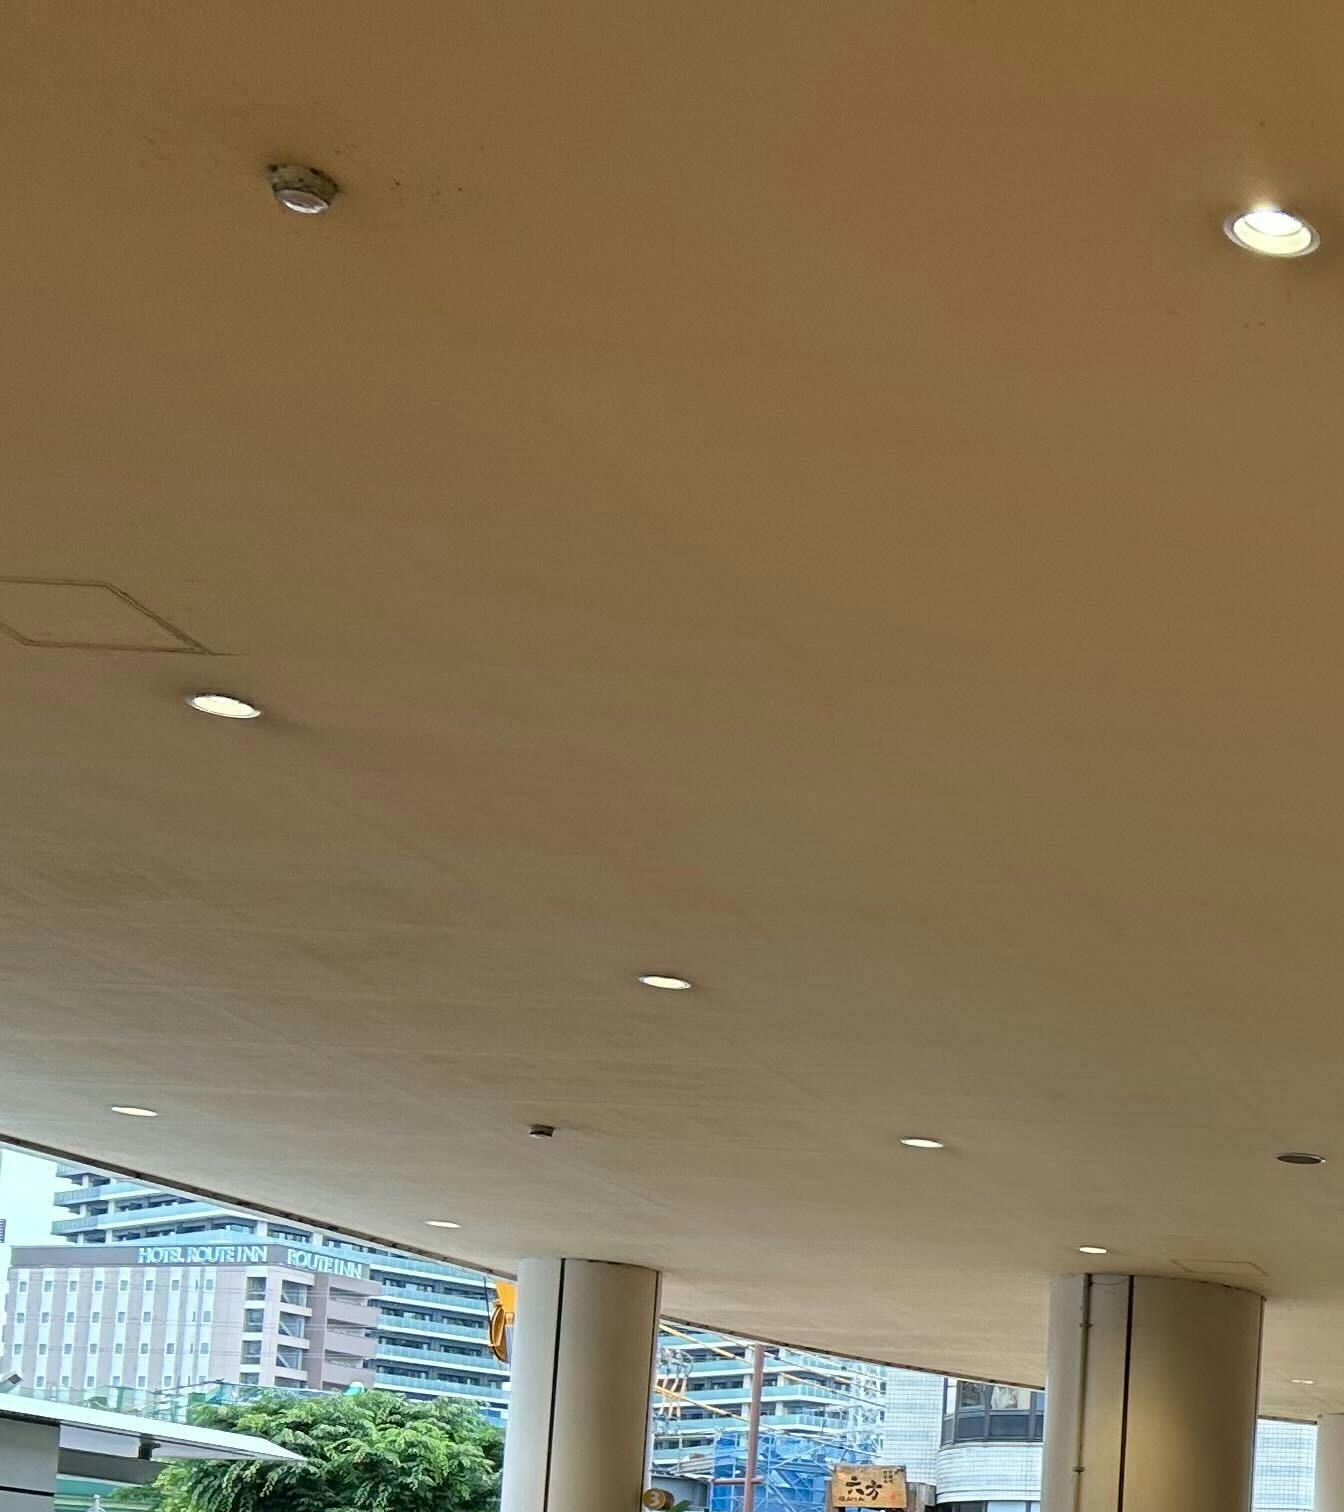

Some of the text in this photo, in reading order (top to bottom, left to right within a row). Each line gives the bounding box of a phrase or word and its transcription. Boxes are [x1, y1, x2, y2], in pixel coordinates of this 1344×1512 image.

[137, 1246, 267, 1264] HOTEL ROUTE INN
[287, 1249, 363, 1279] ROUTE INN
